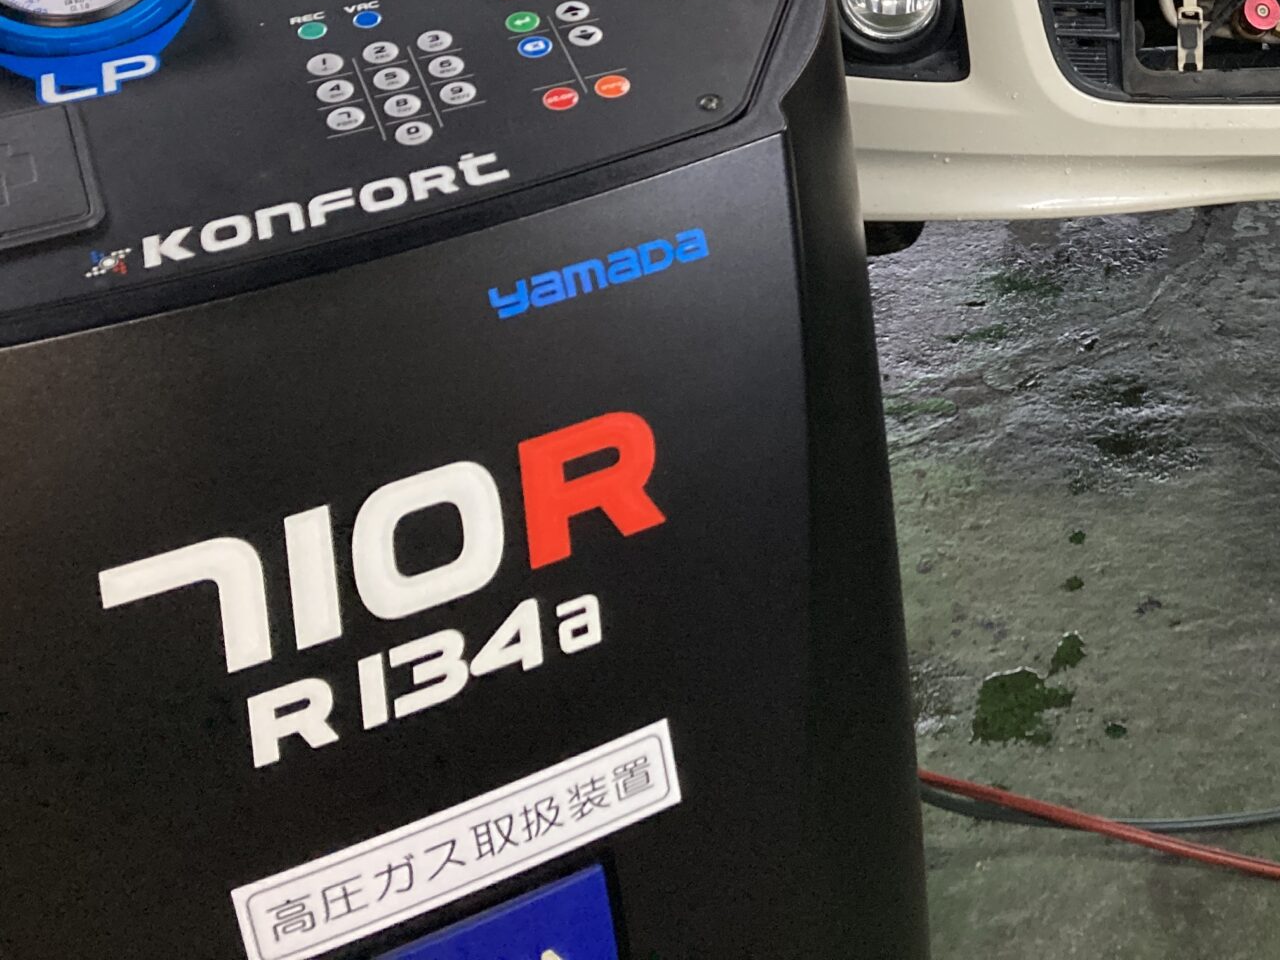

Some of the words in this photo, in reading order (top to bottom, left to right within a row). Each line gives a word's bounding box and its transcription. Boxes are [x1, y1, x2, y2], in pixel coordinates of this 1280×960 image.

[343, 0, 380, 14] VAC
[289, 11, 325, 25] REC
[427, 34, 440, 43] 3
[373, 45, 386, 54] 2
[439, 59, 452, 68] 6
[40, 55, 157, 102] LP
[384, 71, 397, 80] 5
[329, 84, 341, 92] 4
[450, 86, 463, 95] 9
[395, 98, 408, 107] 8
[406, 126, 420, 135] 0
[99, 411, 667, 673] 710R
[246, 593, 603, 768] R134a
[268, 755, 655, 943] 高圧ガス取扱装置
